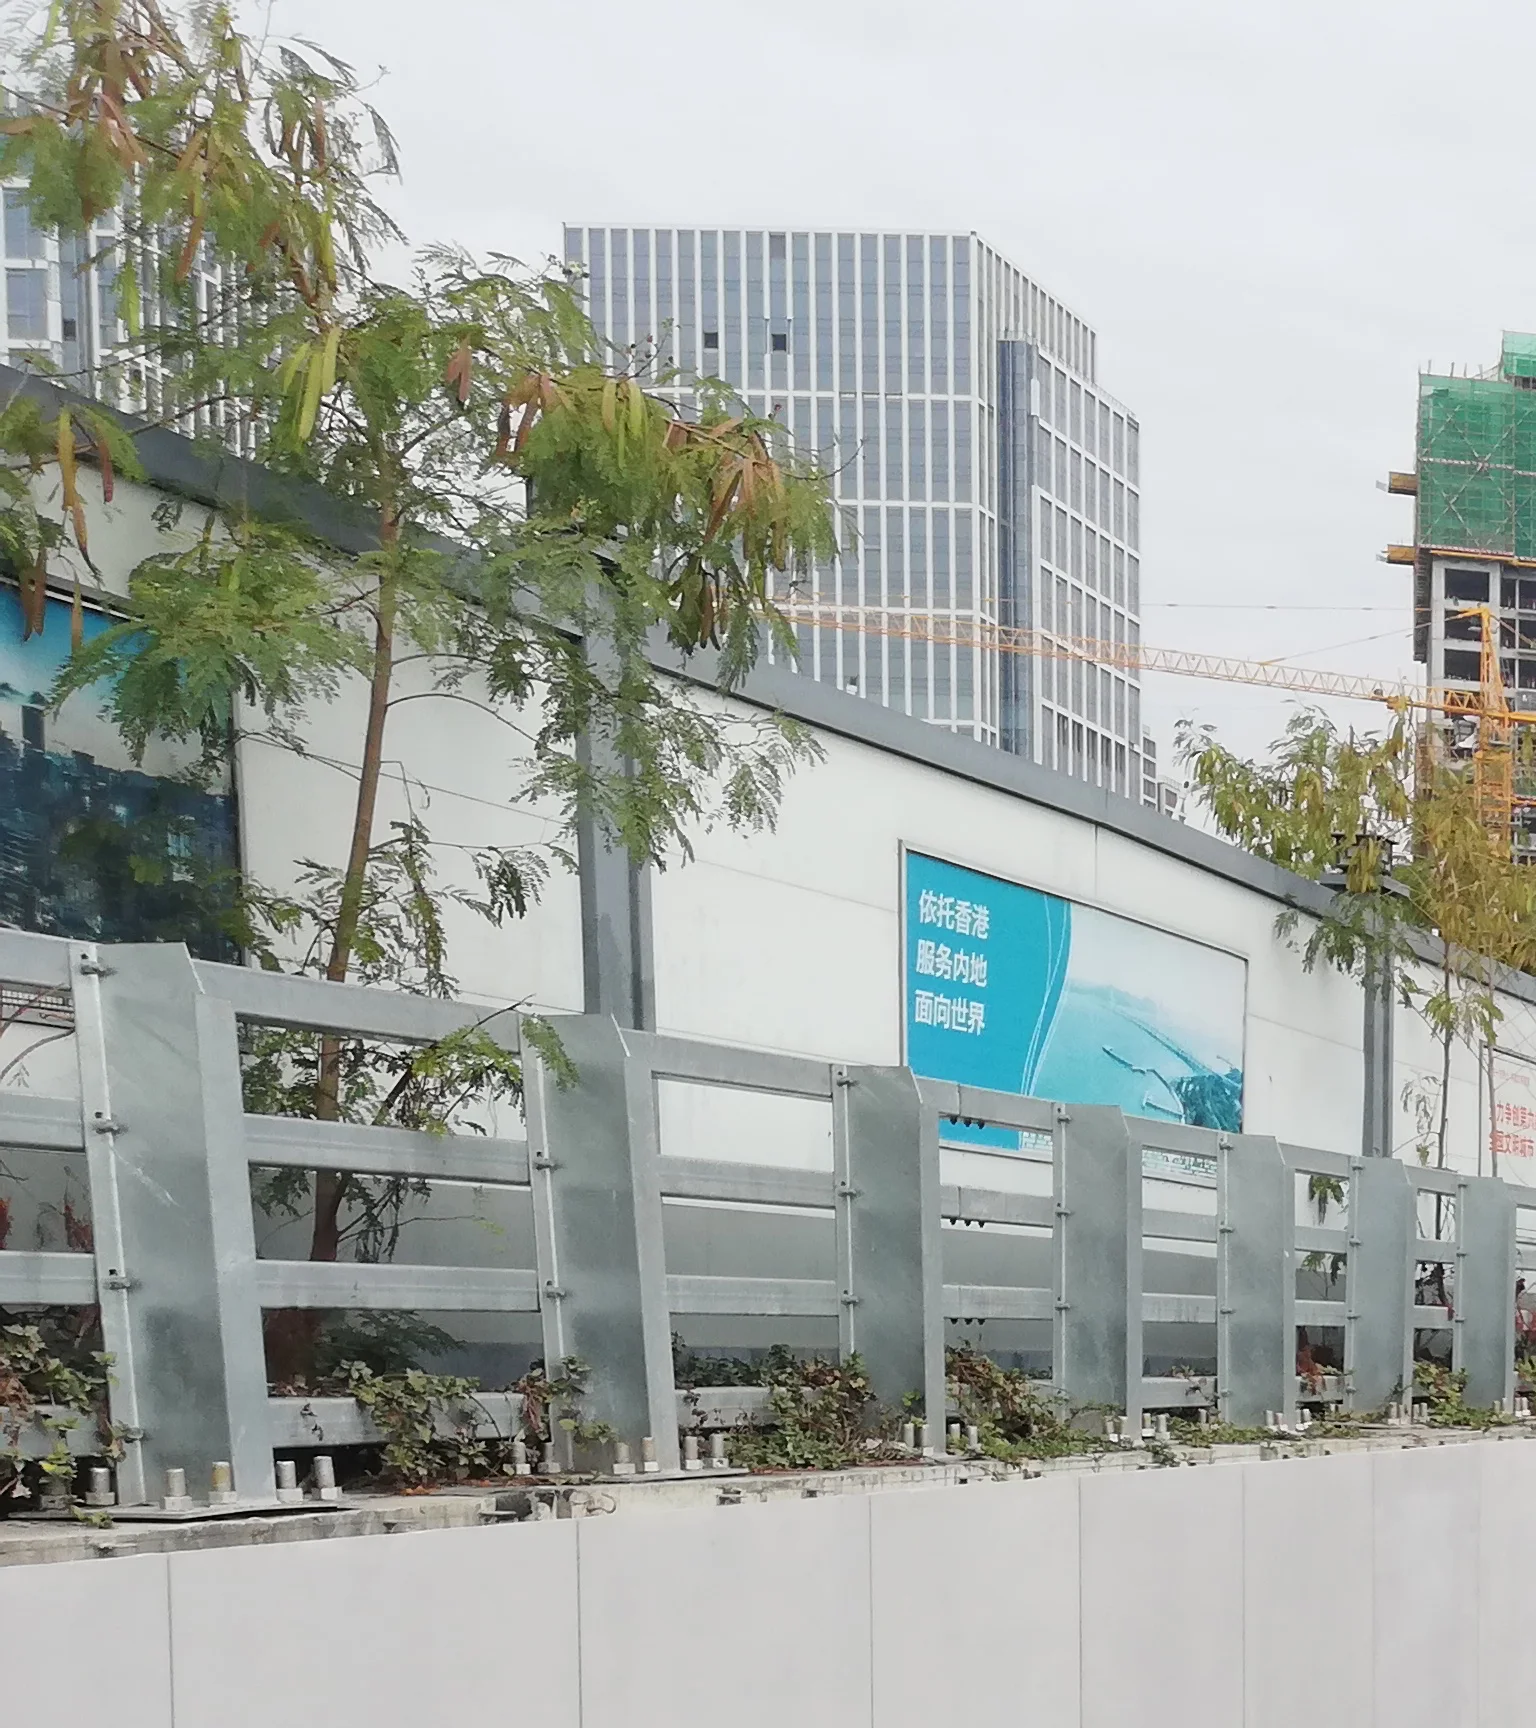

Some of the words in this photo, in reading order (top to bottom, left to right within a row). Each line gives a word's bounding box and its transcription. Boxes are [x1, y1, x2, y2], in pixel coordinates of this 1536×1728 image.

[919, 888, 990, 940] 依托香港
[916, 939, 988, 987] 服务内地
[915, 989, 985, 1036] 面向世界
